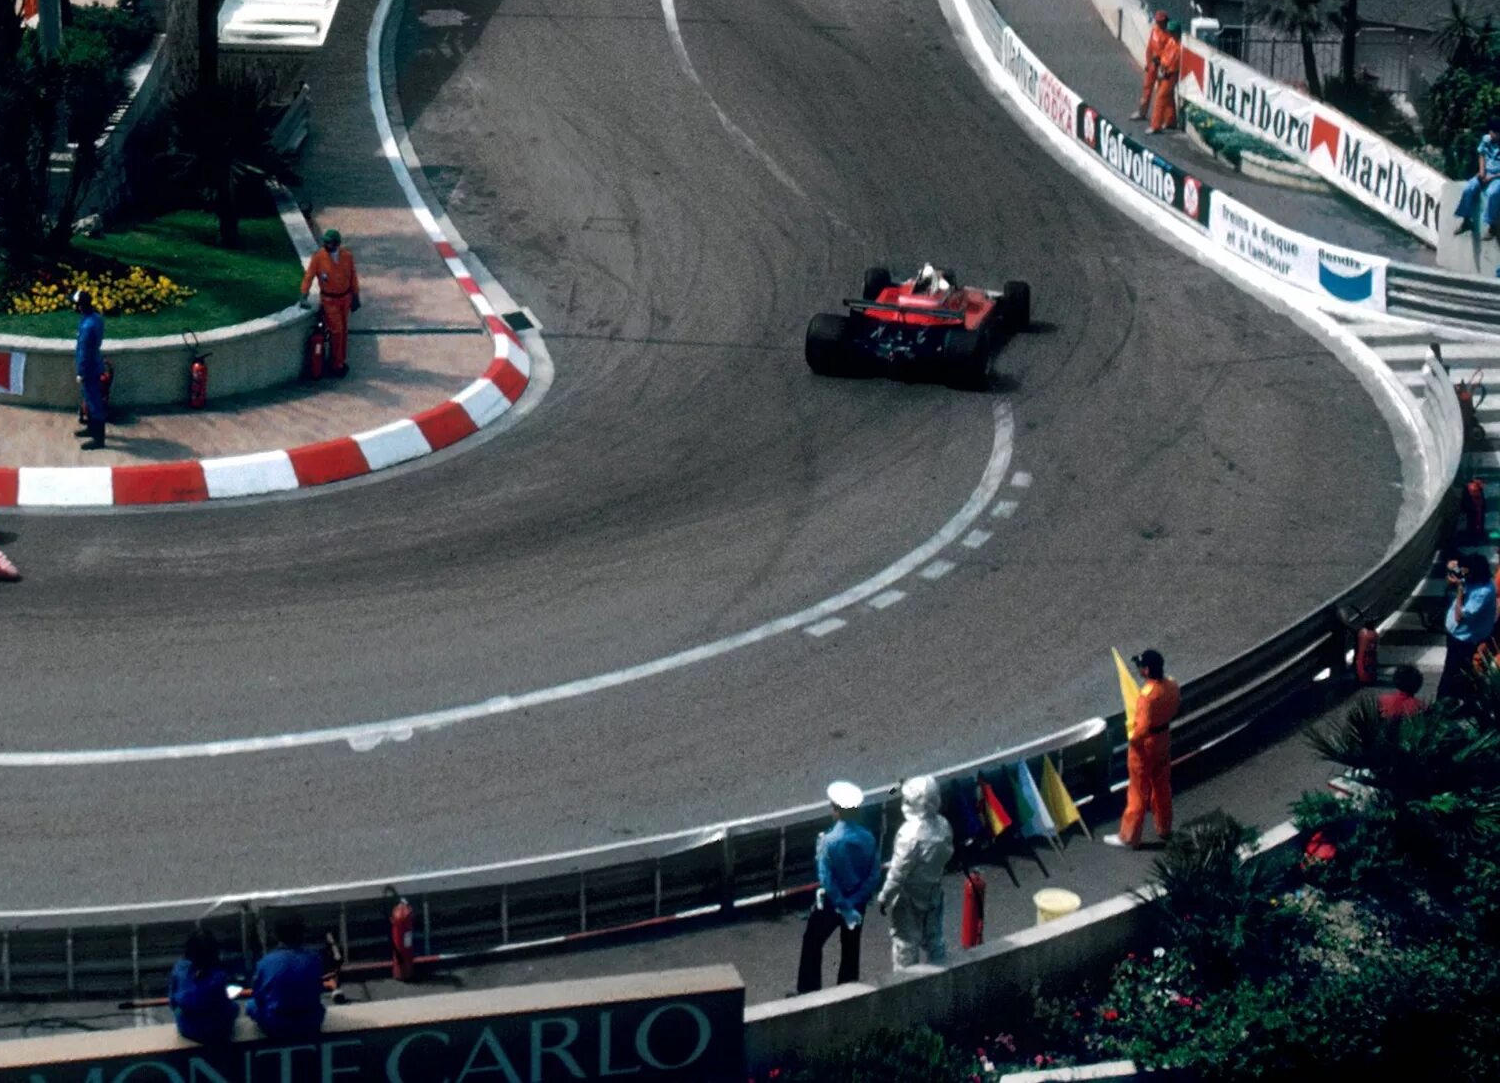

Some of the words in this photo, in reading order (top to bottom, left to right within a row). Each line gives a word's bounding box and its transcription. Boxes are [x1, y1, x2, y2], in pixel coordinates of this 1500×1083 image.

[1207, 62, 1310, 153] Marlboro
[1099, 119, 1177, 206] Valvoline
[1222, 203, 1250, 231] freins
[1260, 226, 1300, 259] disque
[1247, 239, 1292, 276] tambour
[1318, 248, 1364, 269] Bendix
[385, 1002, 712, 1083] CARLO
